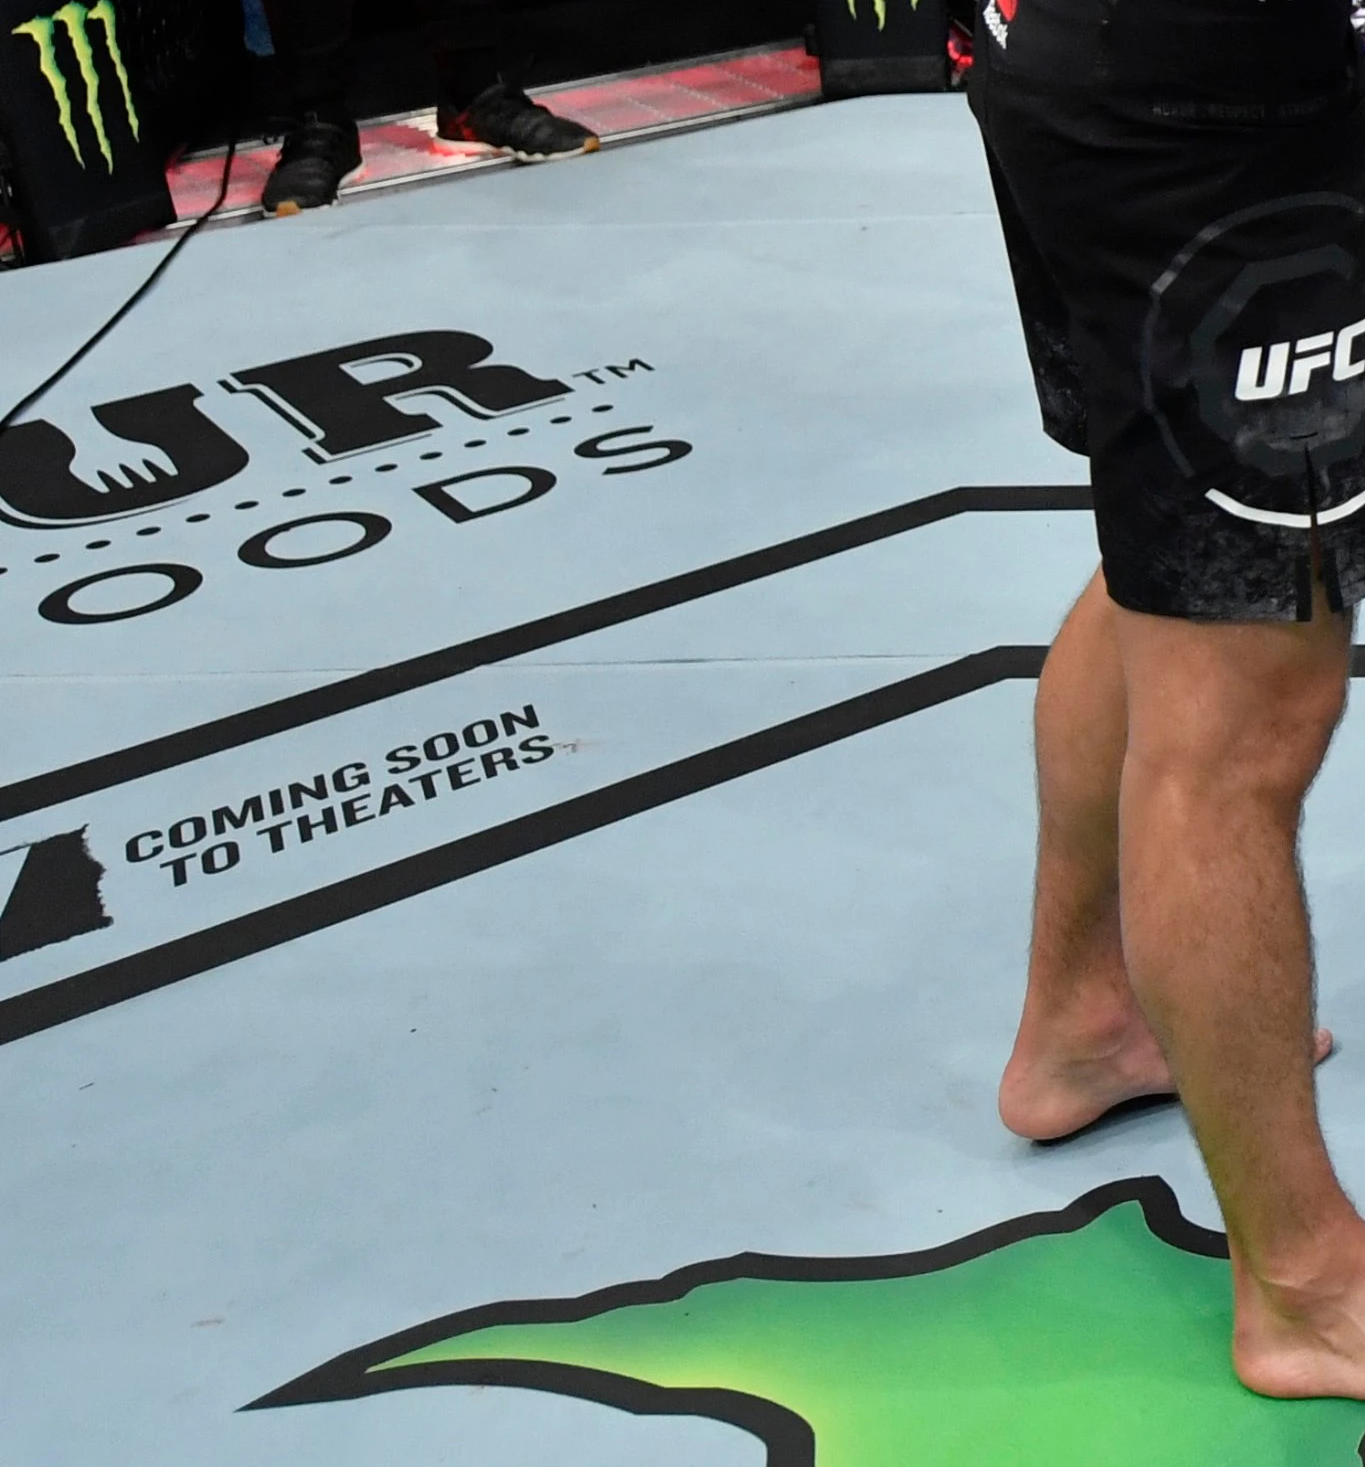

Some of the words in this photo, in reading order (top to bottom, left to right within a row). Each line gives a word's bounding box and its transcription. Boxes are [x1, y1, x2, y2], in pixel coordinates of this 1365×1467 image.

[125, 763, 371, 863] COMING
[385, 704, 540, 774] SOON
[159, 842, 240, 886] TO
[256, 735, 554, 854] THEATERS
